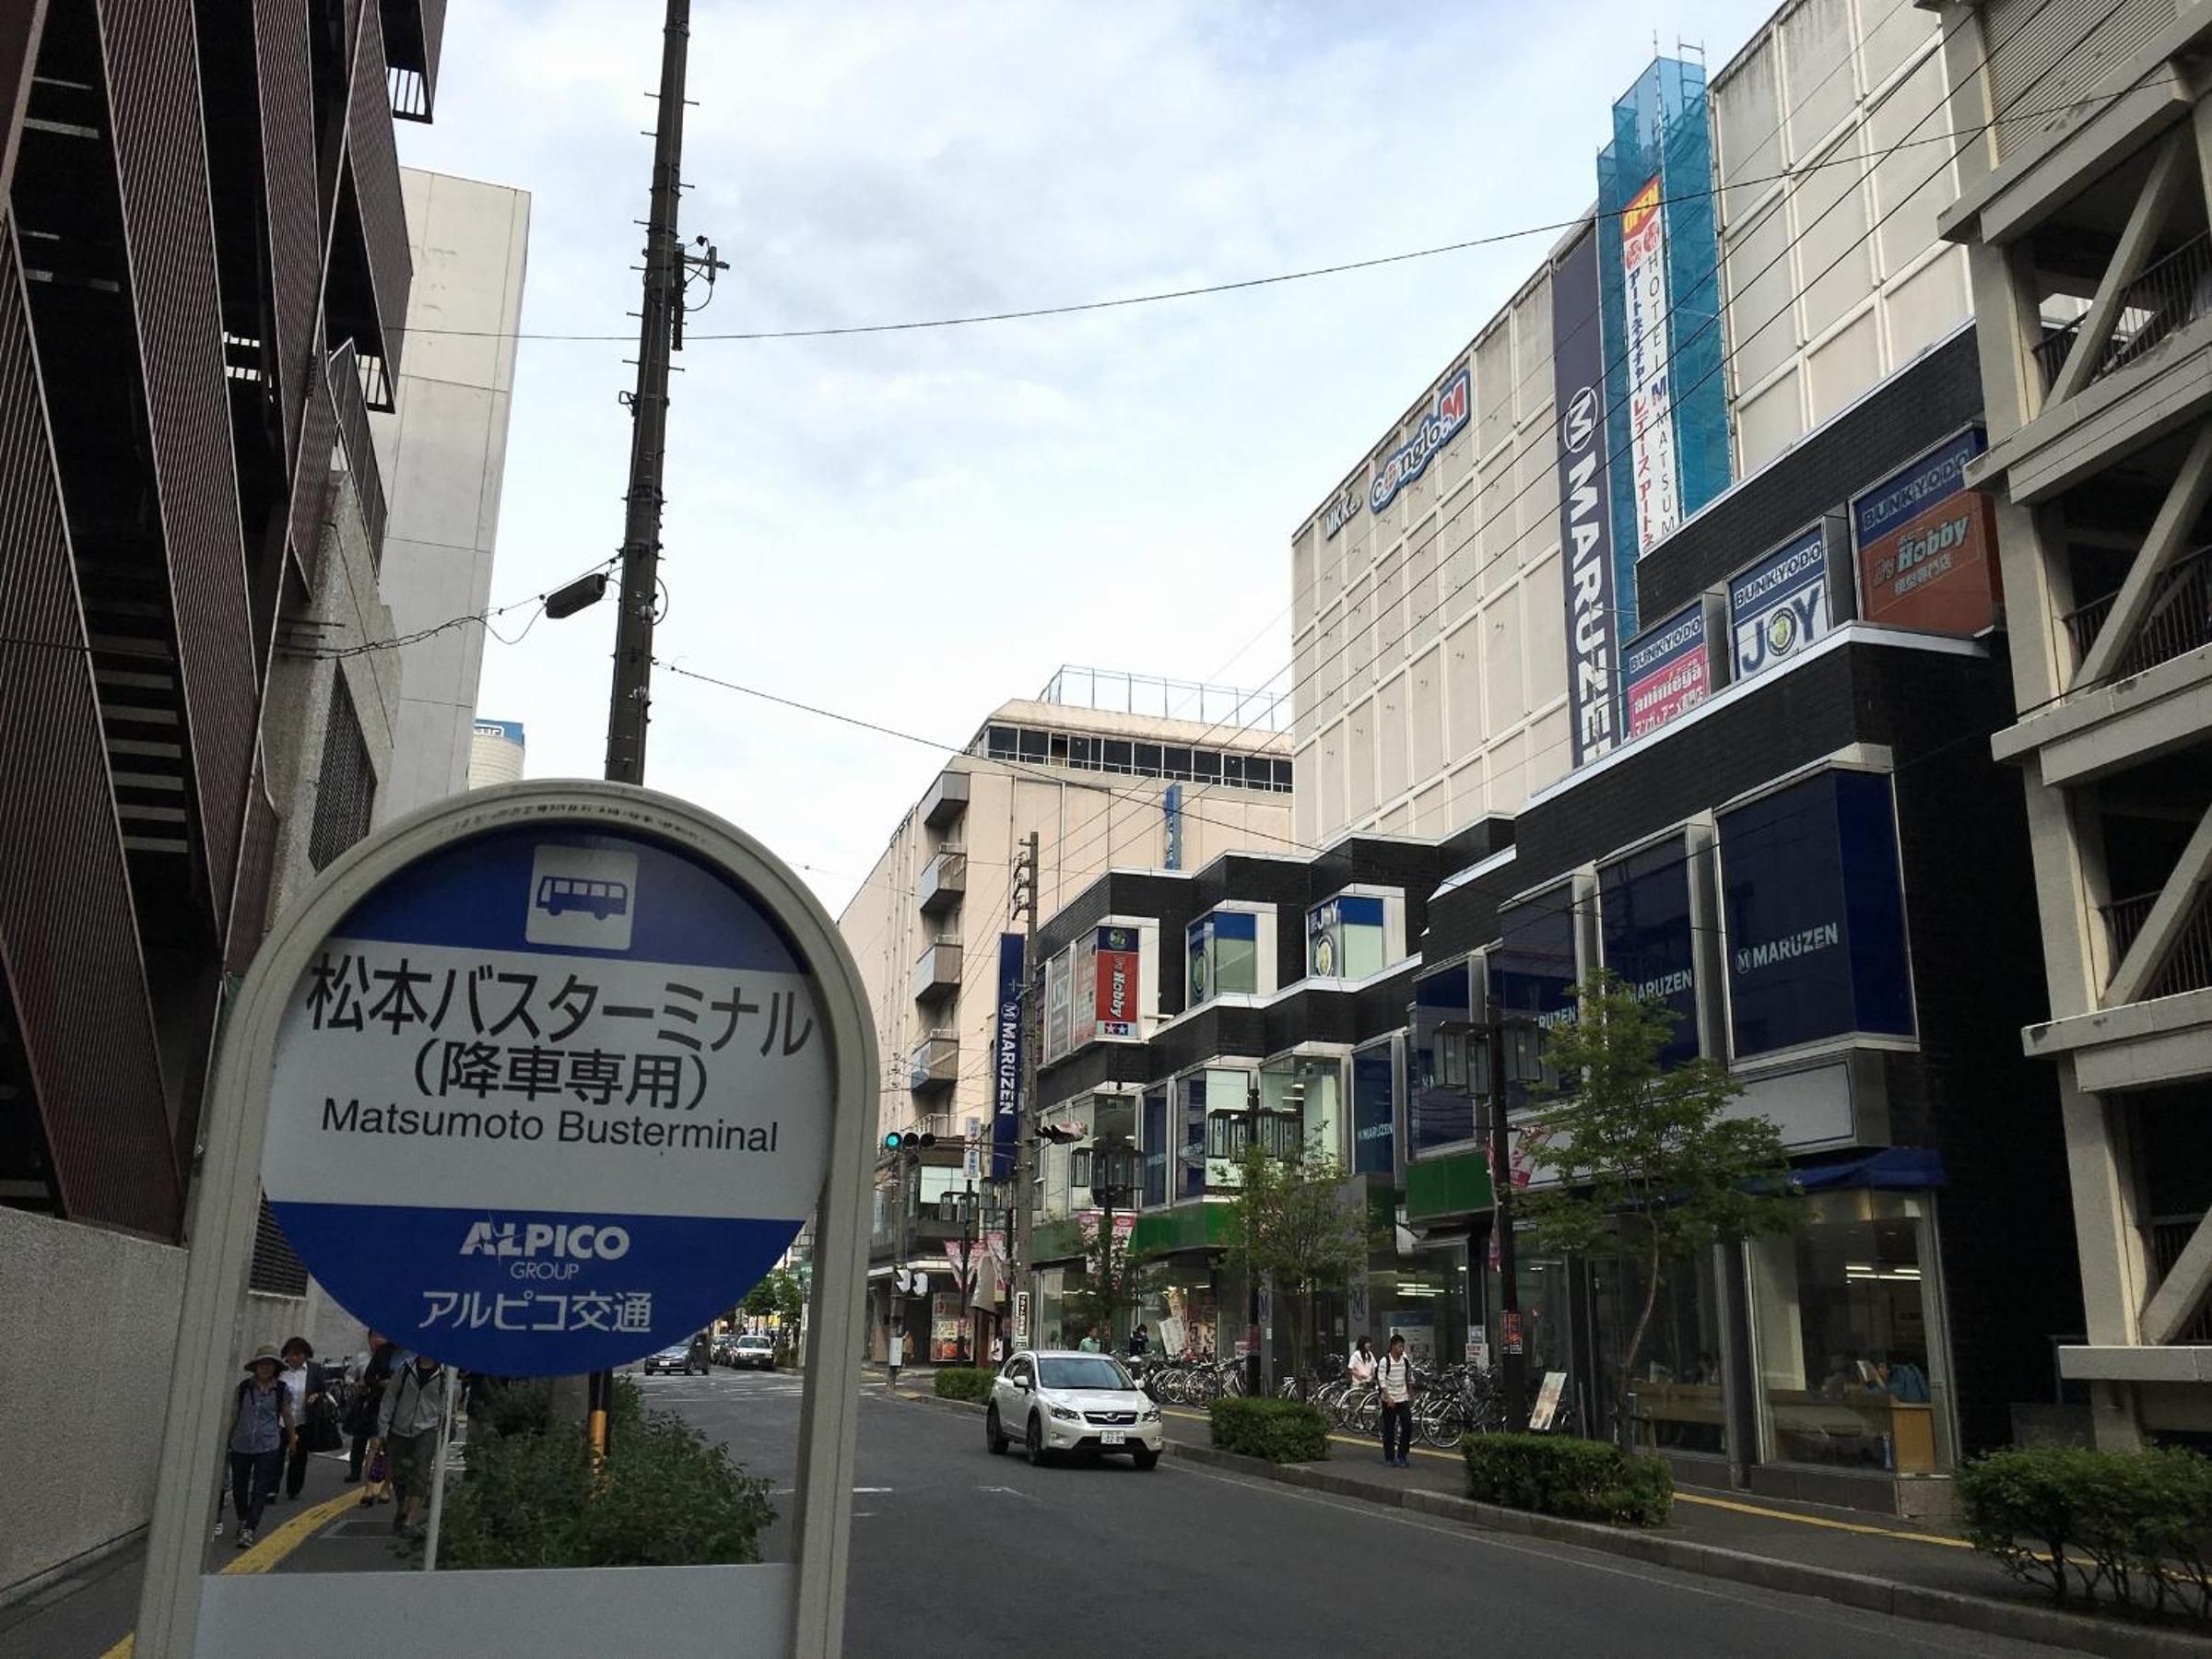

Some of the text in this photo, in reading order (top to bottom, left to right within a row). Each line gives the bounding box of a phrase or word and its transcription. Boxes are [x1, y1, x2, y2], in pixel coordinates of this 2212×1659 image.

[1648, 250, 1661, 371] HOTEL
[1864, 448, 1969, 531] BUNKYODO
[1898, 516, 1970, 573] Hobby
[1735, 541, 1821, 609] BUNKYODO
[1630, 615, 1702, 674] BUNKYODO
[1742, 583, 1821, 673] JOY
[1753, 923, 1838, 968] MARUZEN
[307, 952, 813, 1058] 松本バスターミナル
[1111, 971, 1125, 1018] Hobby
[1537, 1006, 1576, 1030] RUZEN
[414, 1039, 707, 1111] (降車専用)
[1000, 1023, 1017, 1114] MARUZEN
[321, 1098, 778, 1152] Matsumoto Busterminal
[460, 1221, 630, 1260] ALPICO
[510, 1261, 579, 1280] GROUP
[418, 1289, 652, 1333] アルピコ交通
